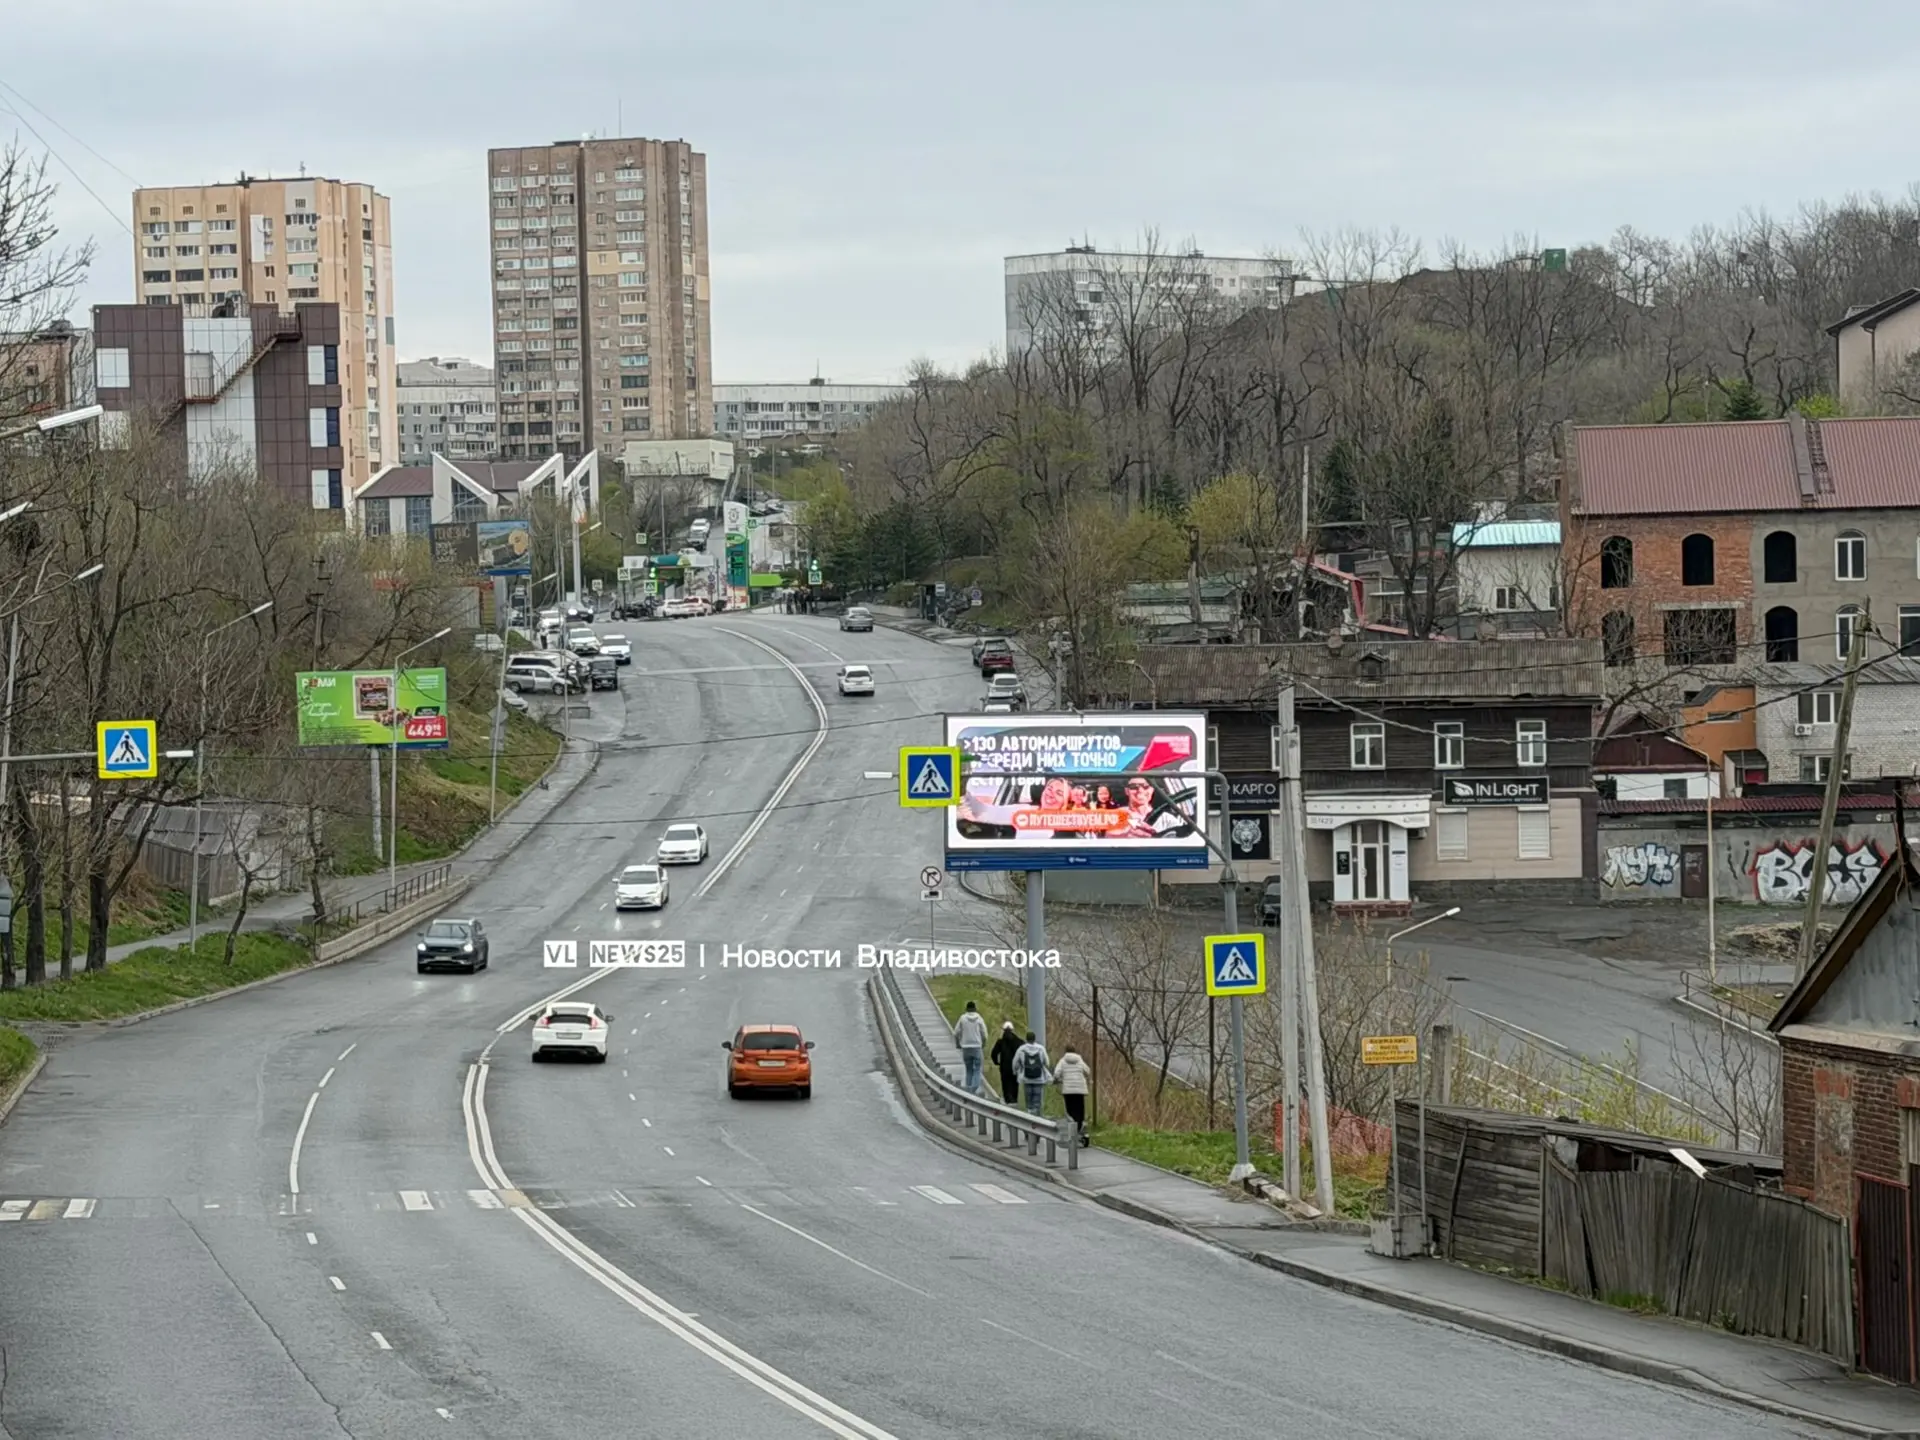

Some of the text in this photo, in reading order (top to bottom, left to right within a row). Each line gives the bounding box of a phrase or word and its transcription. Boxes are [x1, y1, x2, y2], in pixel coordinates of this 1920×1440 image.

[408, 724, 433, 737] 449
[1001, 735, 1127, 753] АВТОМАРШРУТОВ,
[1037, 752, 1066, 768] НИХ
[1071, 751, 1118, 768] ТОЧНО
[1233, 782, 1277, 796] КАРГО
